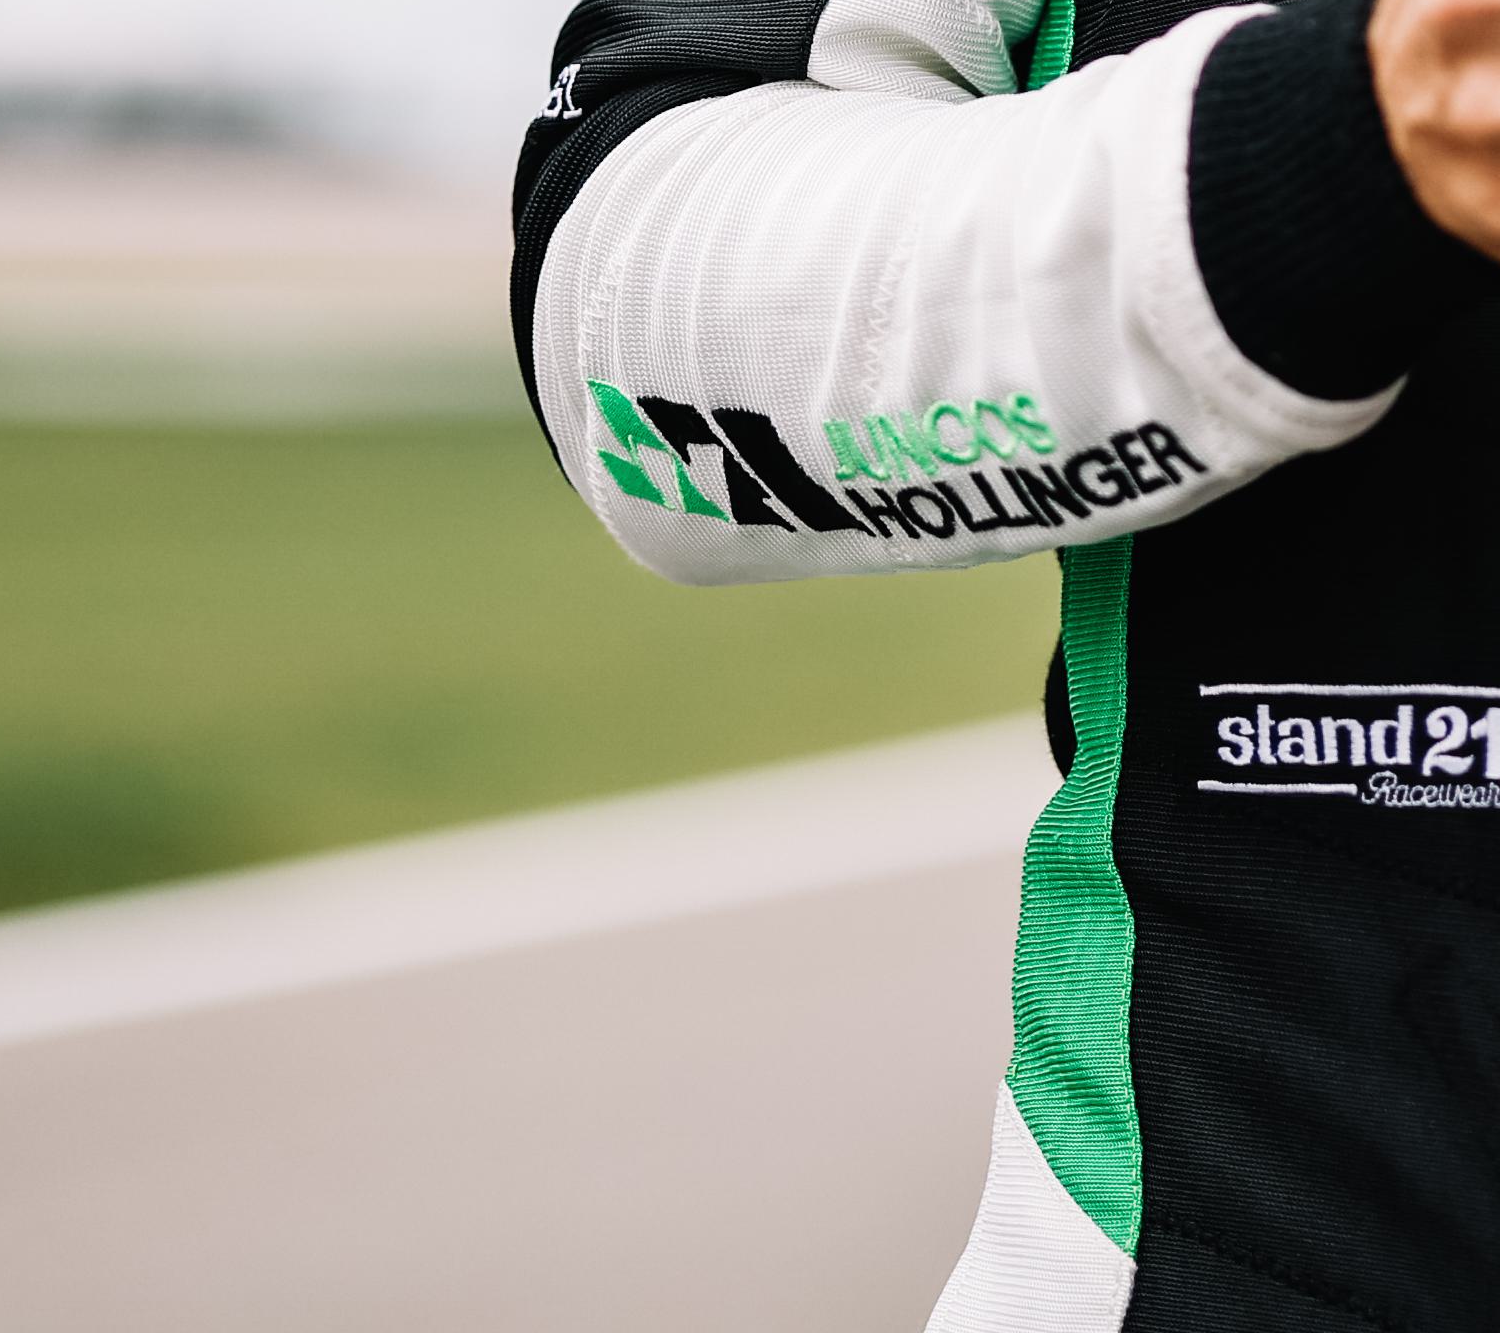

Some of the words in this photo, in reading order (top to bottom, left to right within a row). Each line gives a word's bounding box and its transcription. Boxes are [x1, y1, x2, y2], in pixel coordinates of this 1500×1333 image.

[823, 392, 1058, 481] JUNCOS
[844, 422, 1208, 541] HOLLINGER
[1217, 704, 1414, 766] stand
